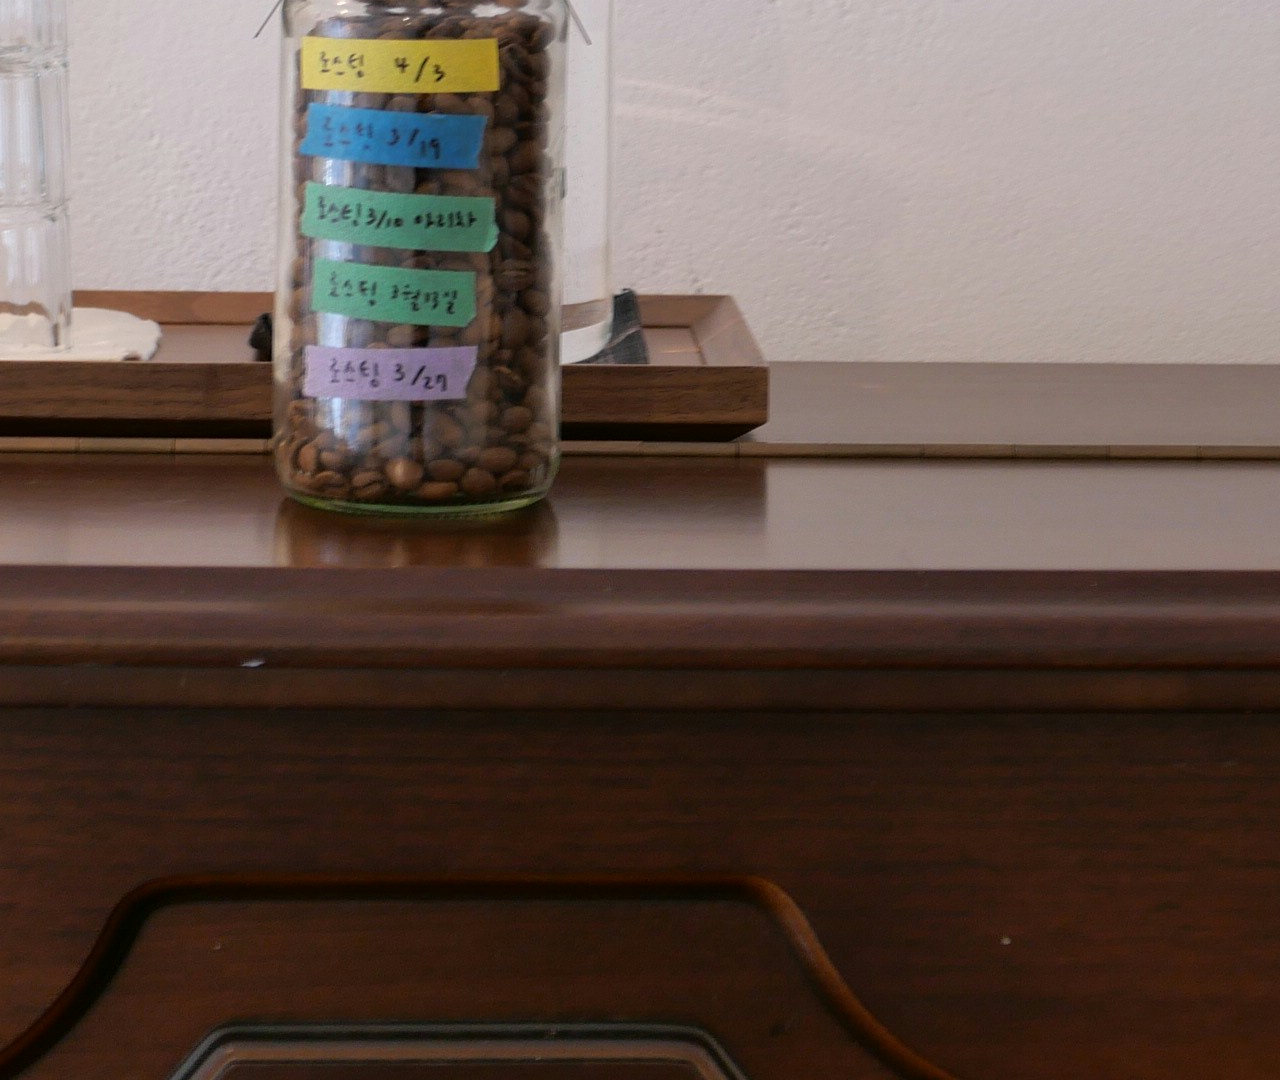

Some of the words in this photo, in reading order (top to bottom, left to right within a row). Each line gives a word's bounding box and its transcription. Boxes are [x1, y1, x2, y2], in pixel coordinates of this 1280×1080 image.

[320, 51, 365, 78] 로스팅
[322, 116, 375, 150] 로스팅
[388, 127, 442, 160] 3/19
[318, 195, 362, 227] 로스팅
[366, 207, 405, 230] 3/10
[329, 271, 377, 307] 로스팅
[330, 357, 380, 387] 로스팅
